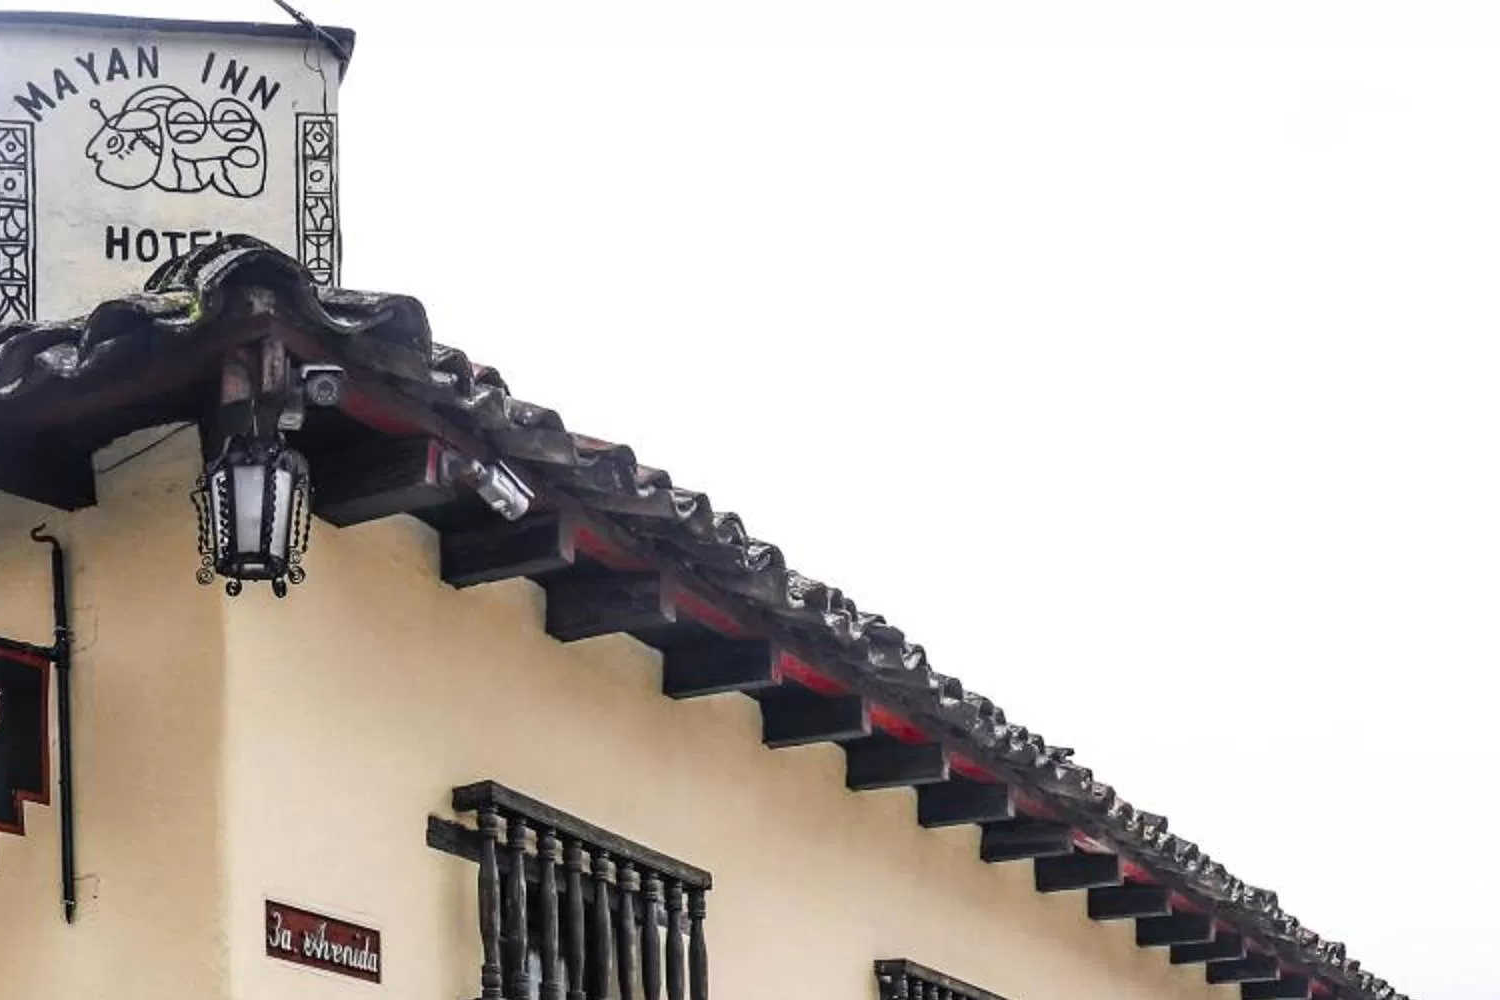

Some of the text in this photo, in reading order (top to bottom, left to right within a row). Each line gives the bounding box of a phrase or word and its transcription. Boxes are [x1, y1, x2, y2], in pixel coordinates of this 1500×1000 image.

[13, 45, 282, 122] MAYAN INN
[105, 225, 223, 263] HOTE
[268, 911, 378, 973] 3a. Avenida
